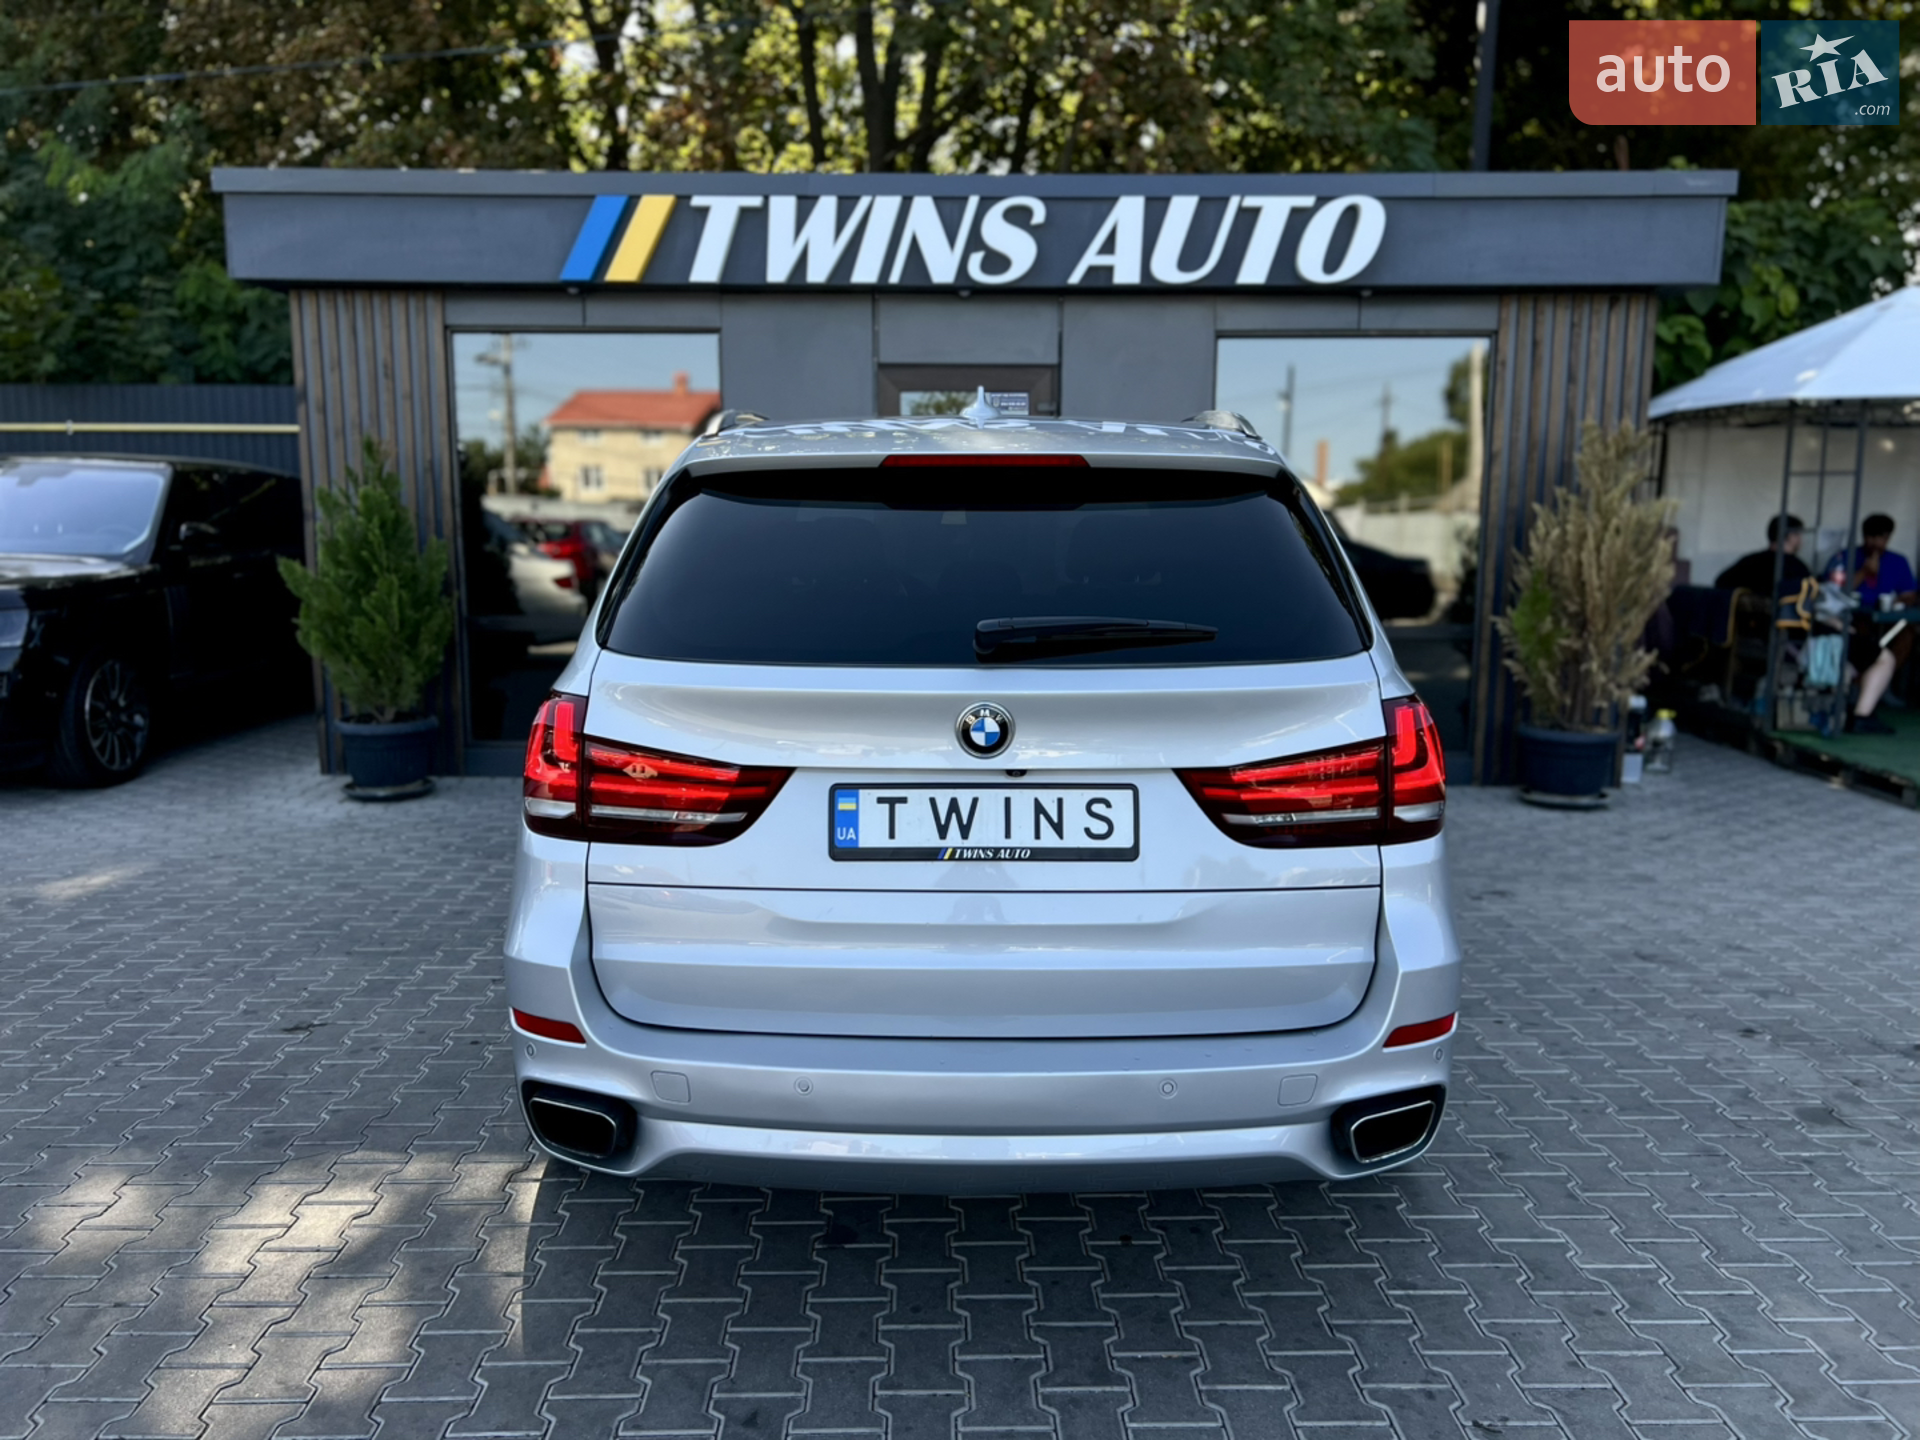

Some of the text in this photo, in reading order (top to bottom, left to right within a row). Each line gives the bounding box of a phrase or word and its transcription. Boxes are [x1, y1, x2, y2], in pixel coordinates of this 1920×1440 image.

[689, 195, 1386, 284] TWINS AUTO
[876, 796, 1114, 841] TWINS
[837, 827, 857, 841] UA
[954, 848, 1031, 859] TWINS AUTO
